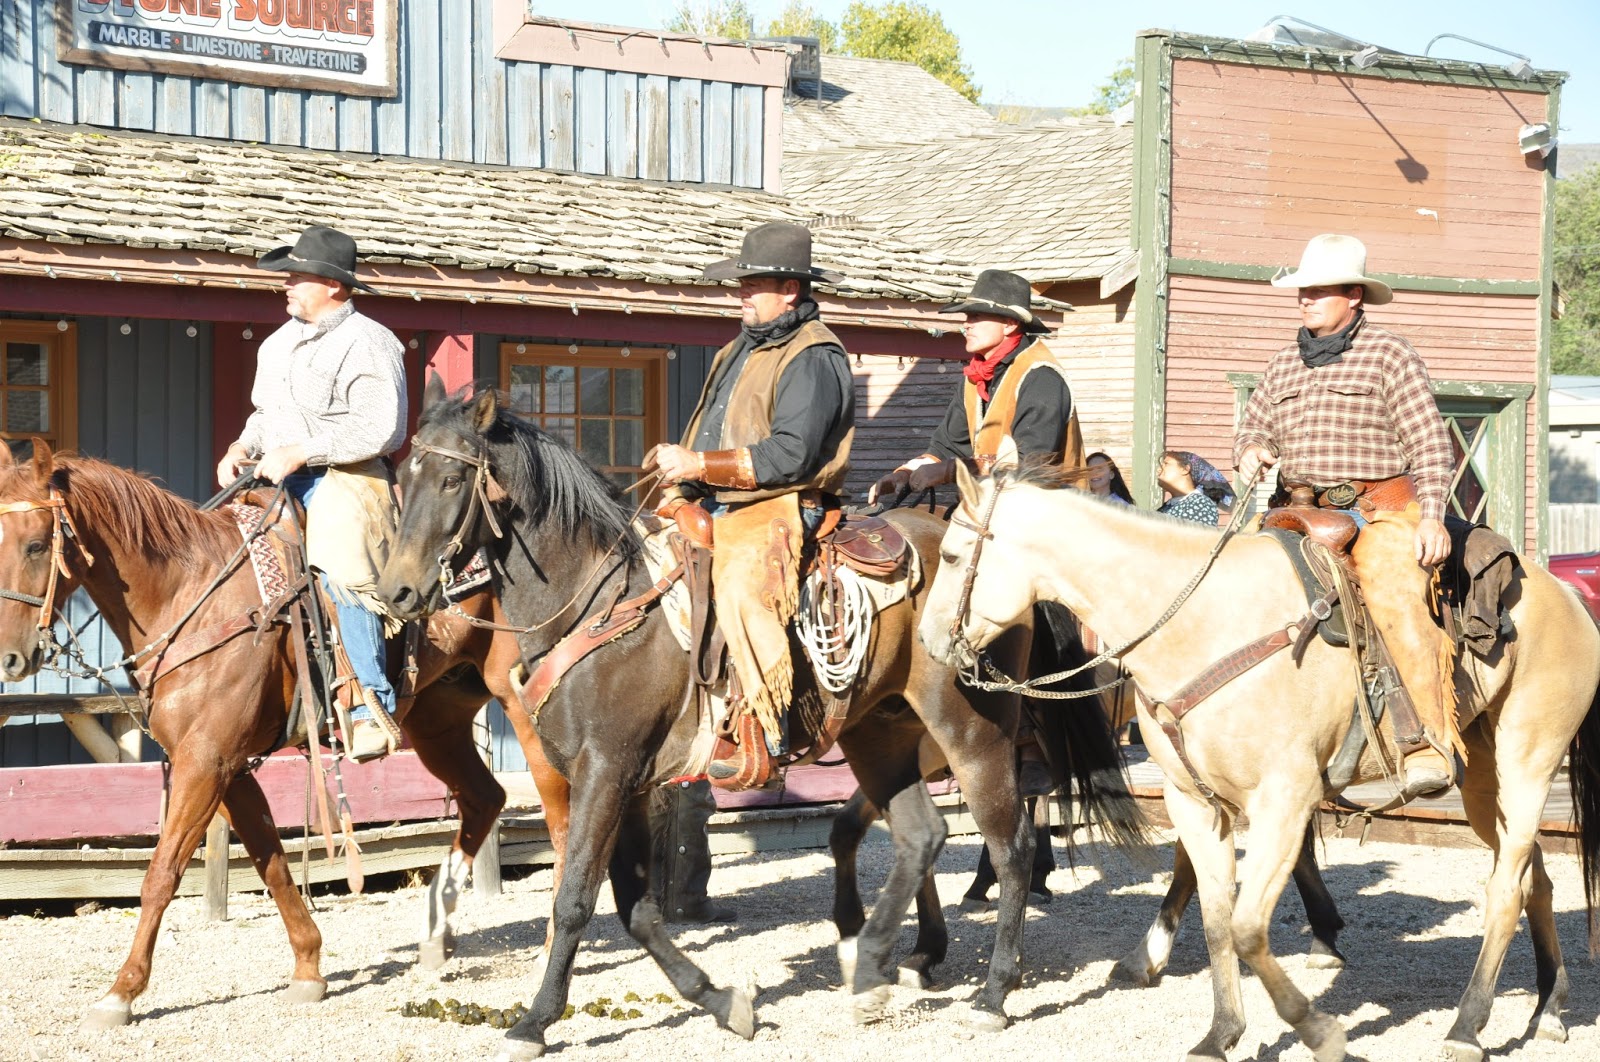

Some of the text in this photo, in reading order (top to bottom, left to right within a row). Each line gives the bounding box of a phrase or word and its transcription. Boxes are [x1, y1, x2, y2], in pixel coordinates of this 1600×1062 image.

[235, 0, 374, 37] SOURCE
[98, 23, 359, 71] MARBLE LIMESTONE TRAVERTINE
